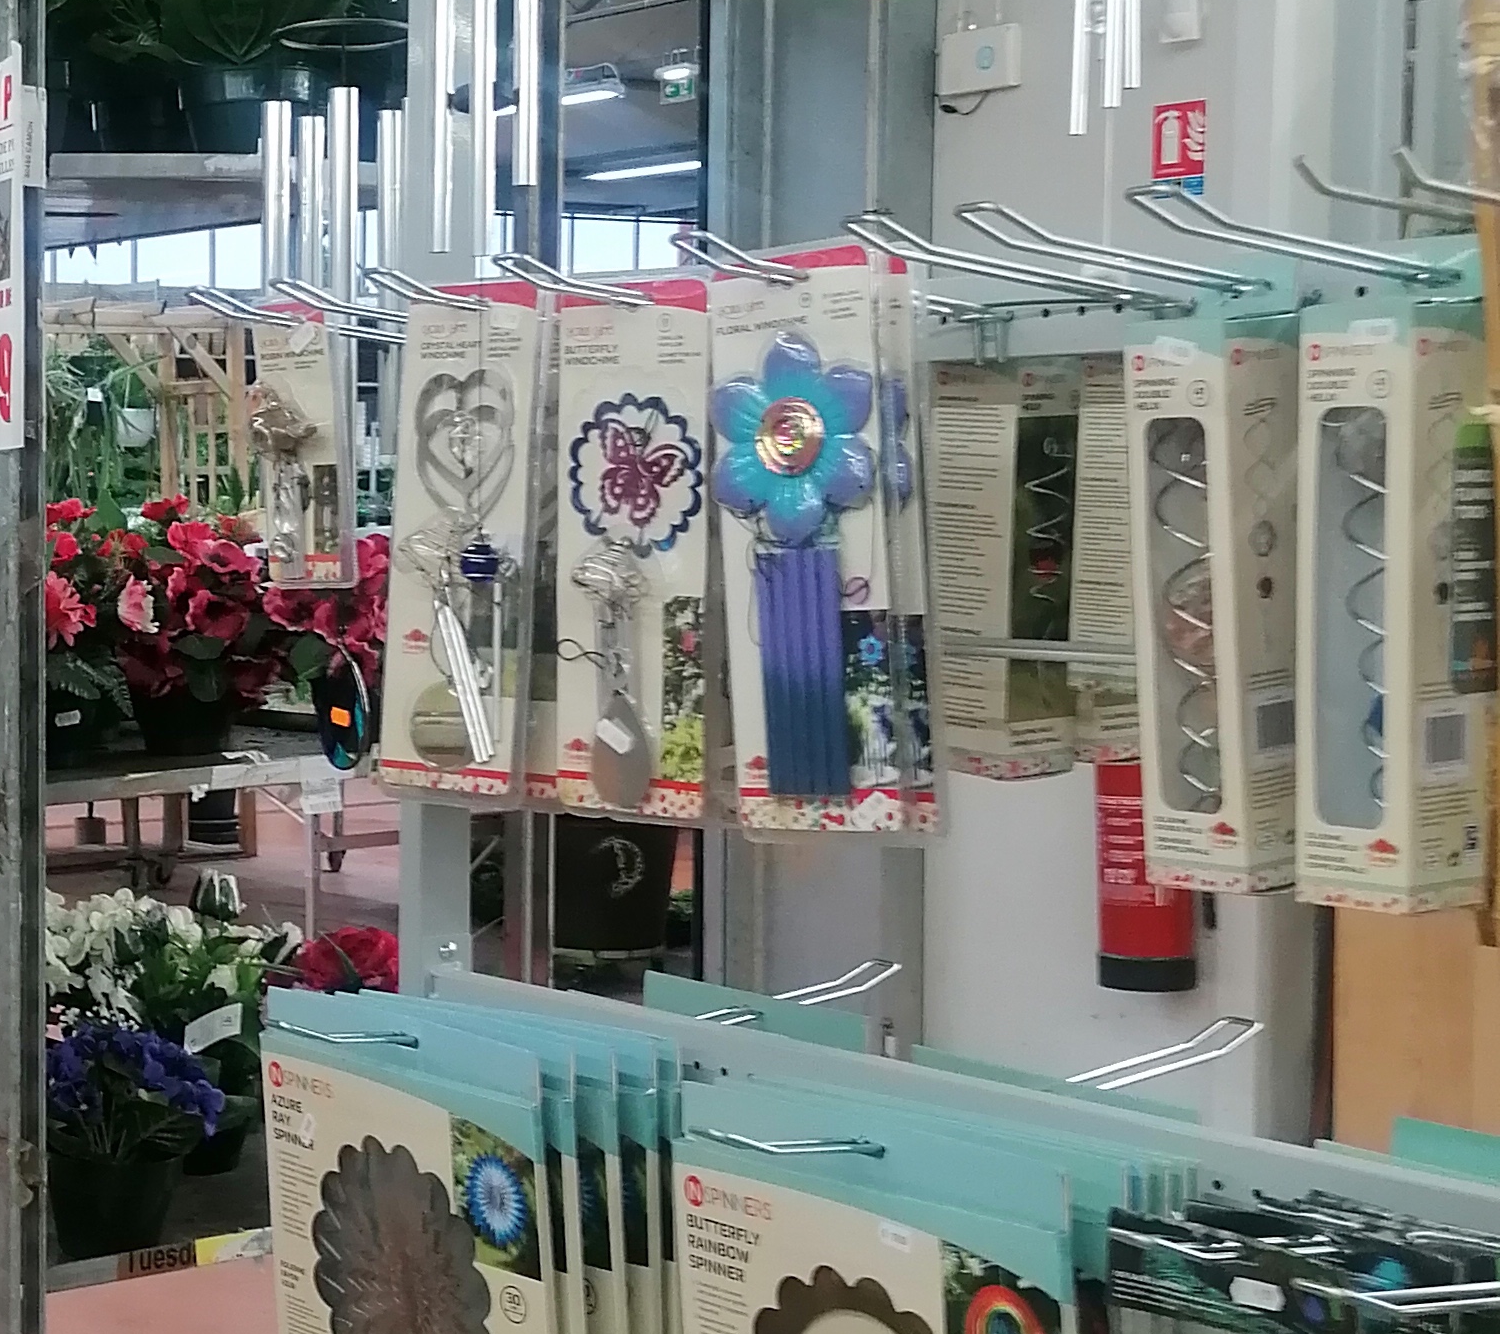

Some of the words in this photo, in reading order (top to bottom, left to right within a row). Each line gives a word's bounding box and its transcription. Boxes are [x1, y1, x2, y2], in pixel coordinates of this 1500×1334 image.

[272, 1110, 291, 1126] RAY
[686, 1213, 760, 1246] BUTTERFLY
[687, 1233, 749, 1264] RAINBOW
[688, 1253, 746, 1283] SPINNER
